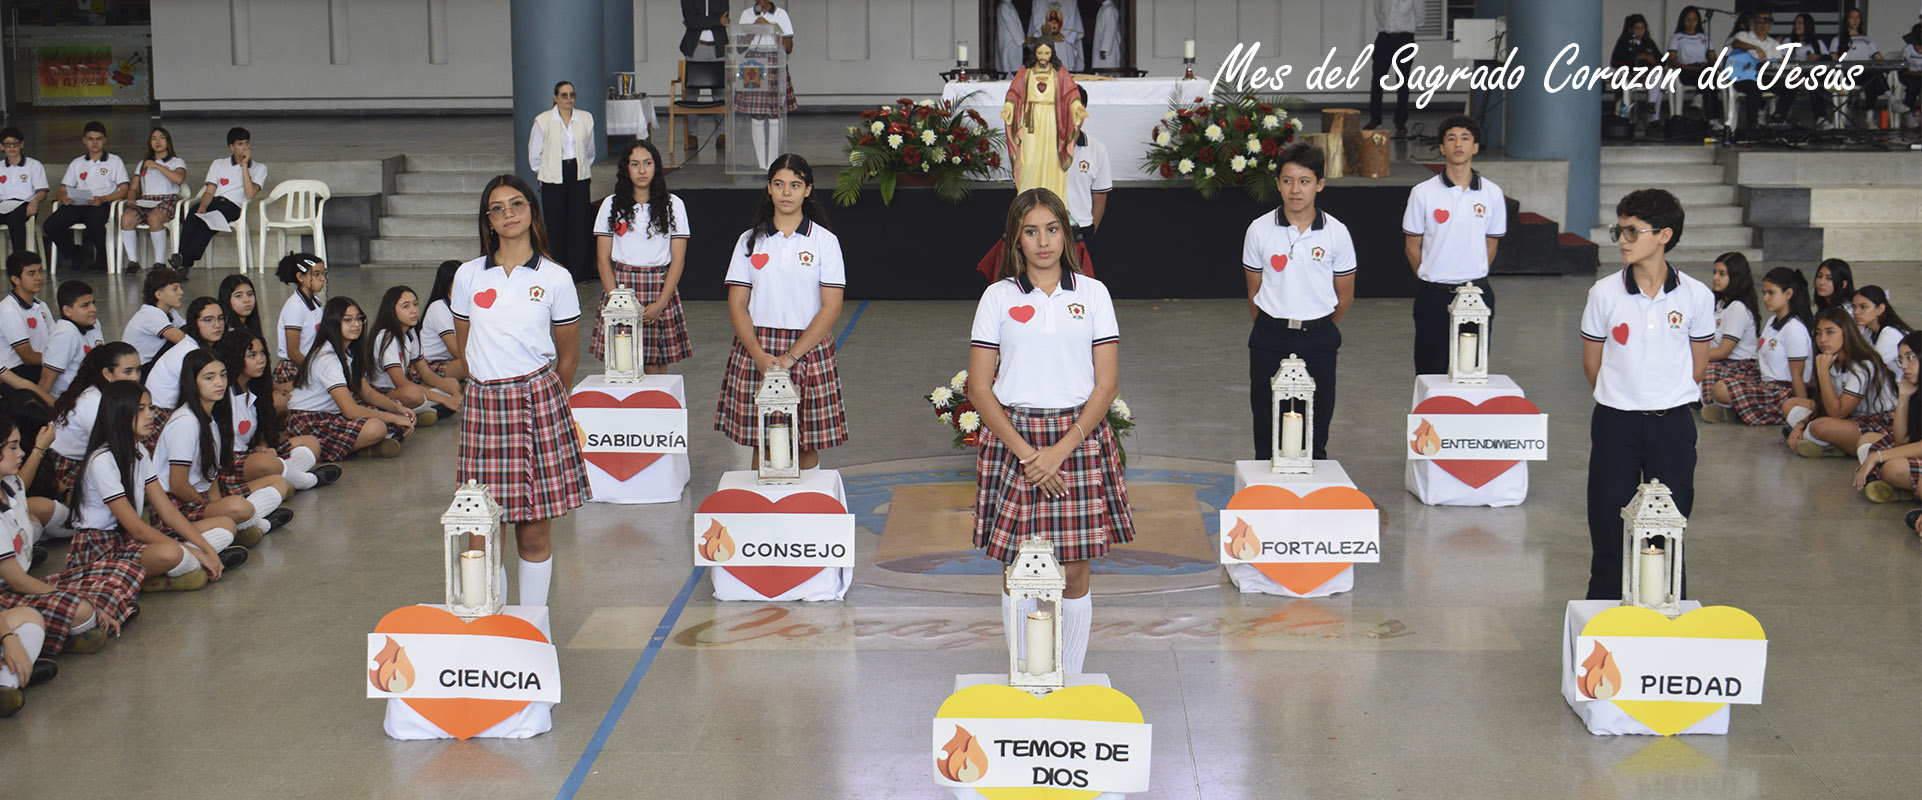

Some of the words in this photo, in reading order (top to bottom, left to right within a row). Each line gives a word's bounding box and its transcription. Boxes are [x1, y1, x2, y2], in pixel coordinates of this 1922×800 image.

[587, 430, 687, 448] SABIDURÍA
[1440, 438, 1546, 450] ENTENDIMIENTO
[741, 543, 846, 558] CONSEJO
[1261, 540, 1379, 555] FORTALEZA
[439, 669, 541, 690] CIENCIA
[1641, 675, 1742, 697] PIEDAD
[993, 739, 1087, 759] TEMOR
[1094, 742, 1129, 762] DE
[1032, 766, 1089, 788] DIOS
